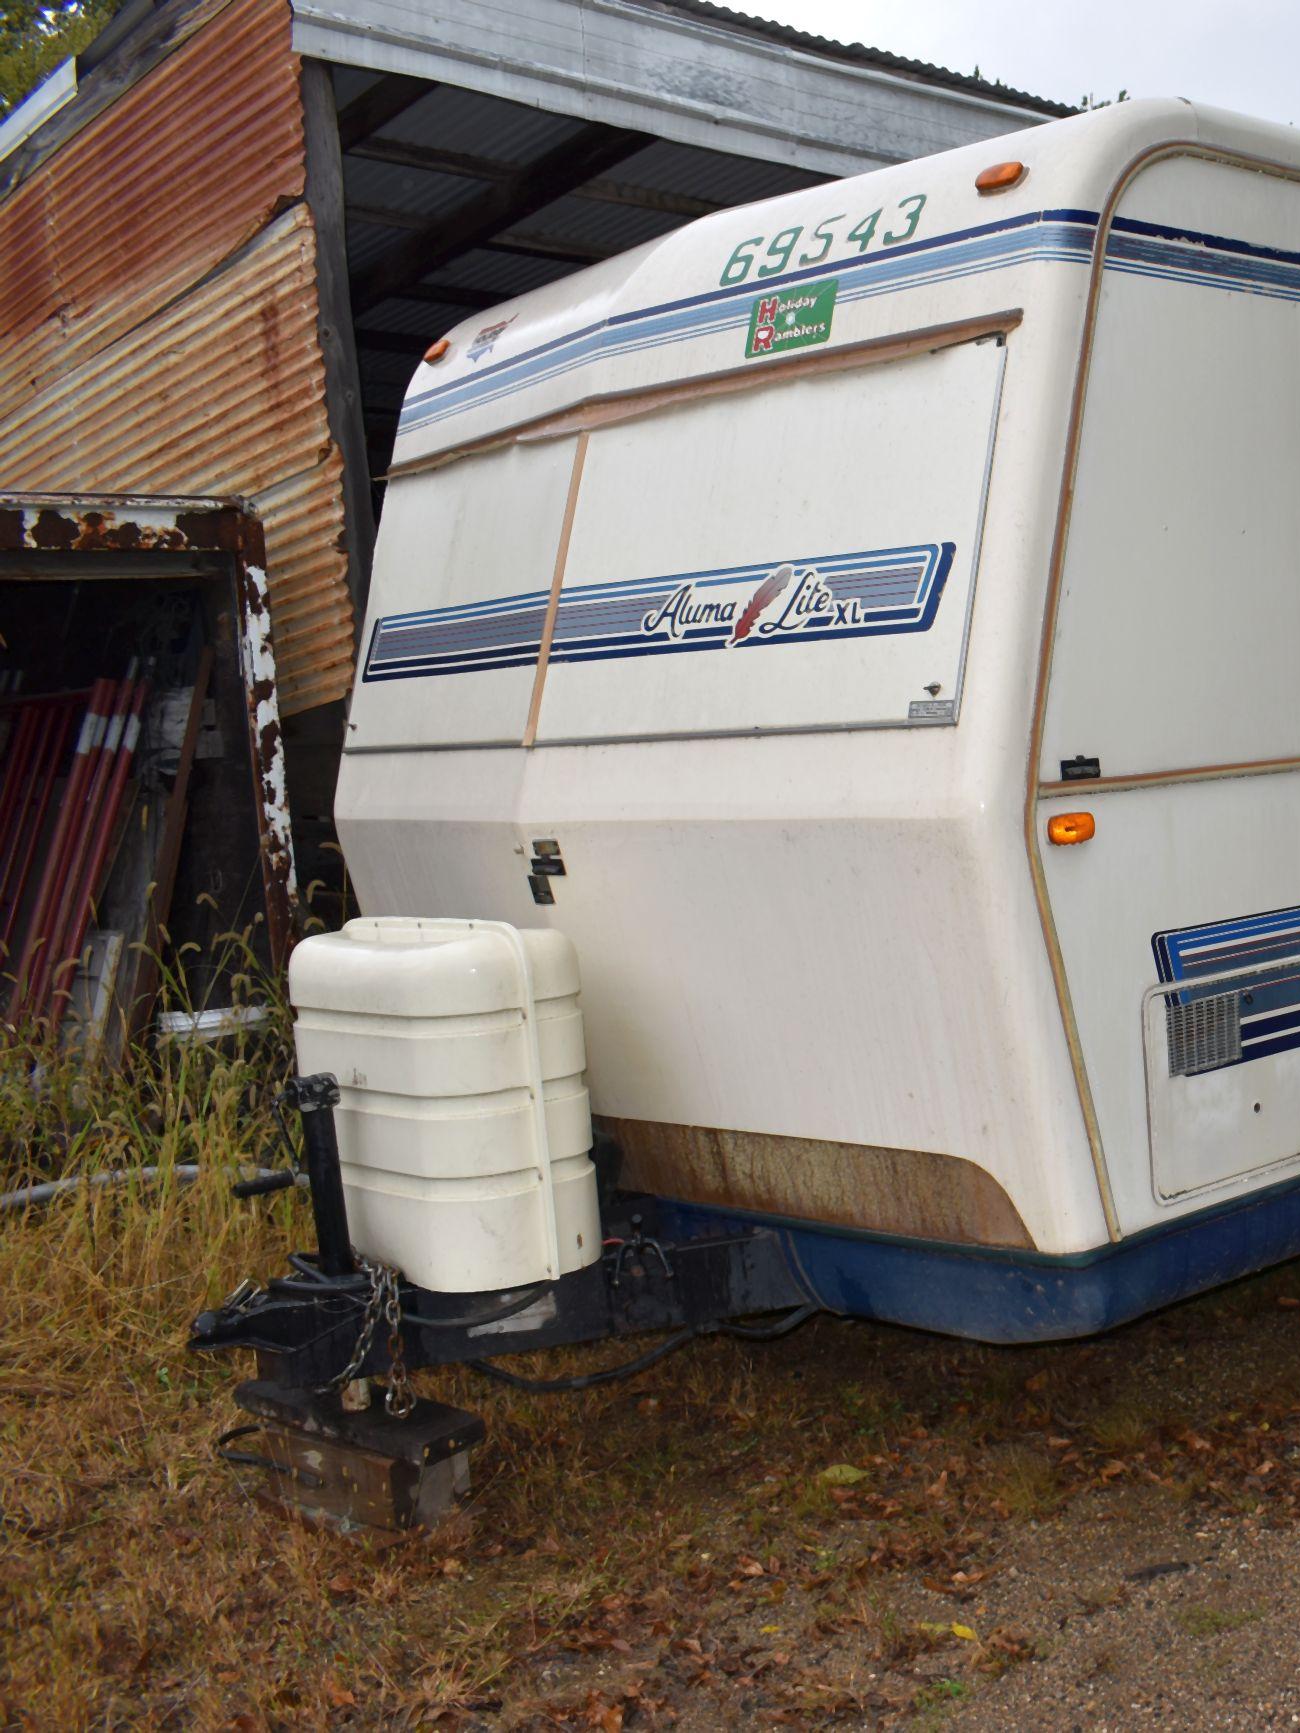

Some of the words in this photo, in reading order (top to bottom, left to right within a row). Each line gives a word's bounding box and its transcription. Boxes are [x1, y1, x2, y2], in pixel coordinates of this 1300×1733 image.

[719, 194, 928, 287] 69543
[757, 295, 818, 325] Holiday
[752, 322, 826, 354] Ramblers
[643, 582, 737, 639] Aluma
[758, 571, 832, 634] Lite
[833, 600, 862, 625] XL
